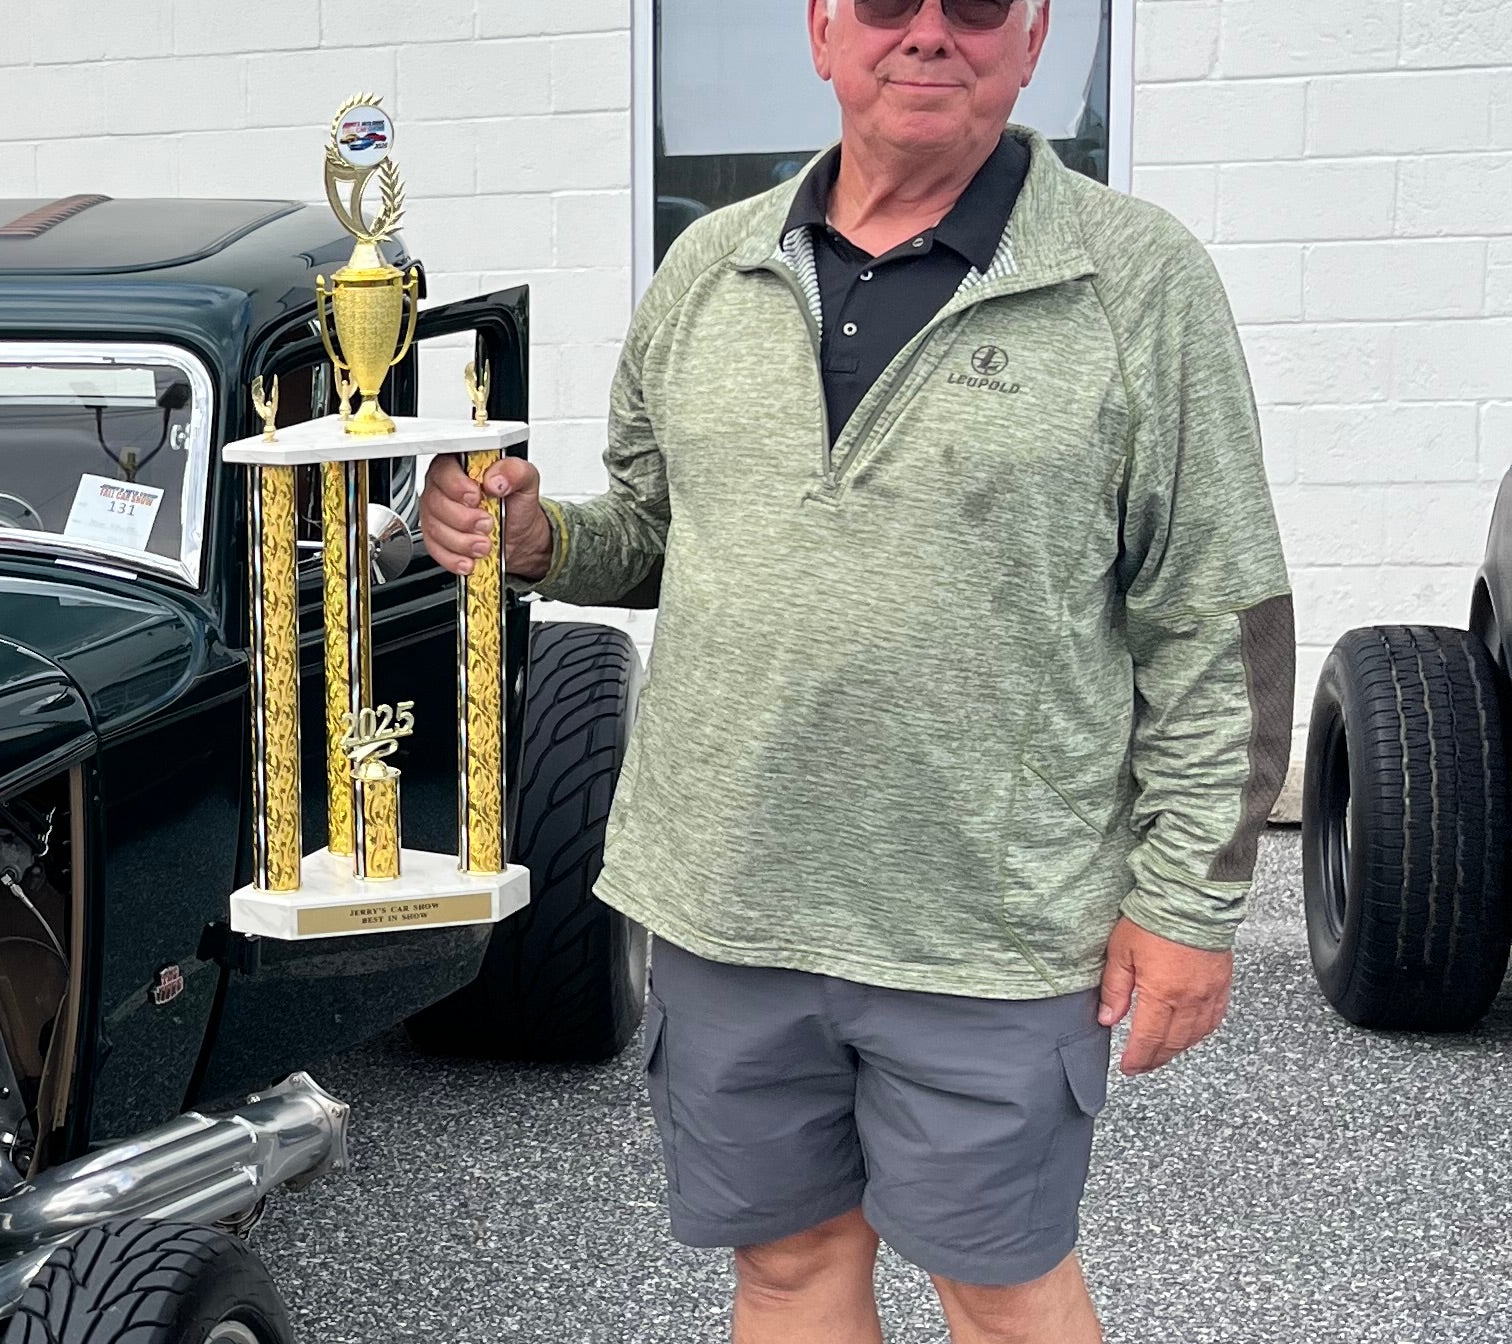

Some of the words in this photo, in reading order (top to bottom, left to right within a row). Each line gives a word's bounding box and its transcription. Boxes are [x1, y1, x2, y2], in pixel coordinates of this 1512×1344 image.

[107, 500, 135, 516] 131
[340, 700, 415, 745] 2025
[390, 905, 410, 913] CAR
[413, 902, 440, 911] SHOW
[361, 916, 384, 924] BEST
[388, 914, 398, 922] IN
[401, 912, 428, 921] SHOW
